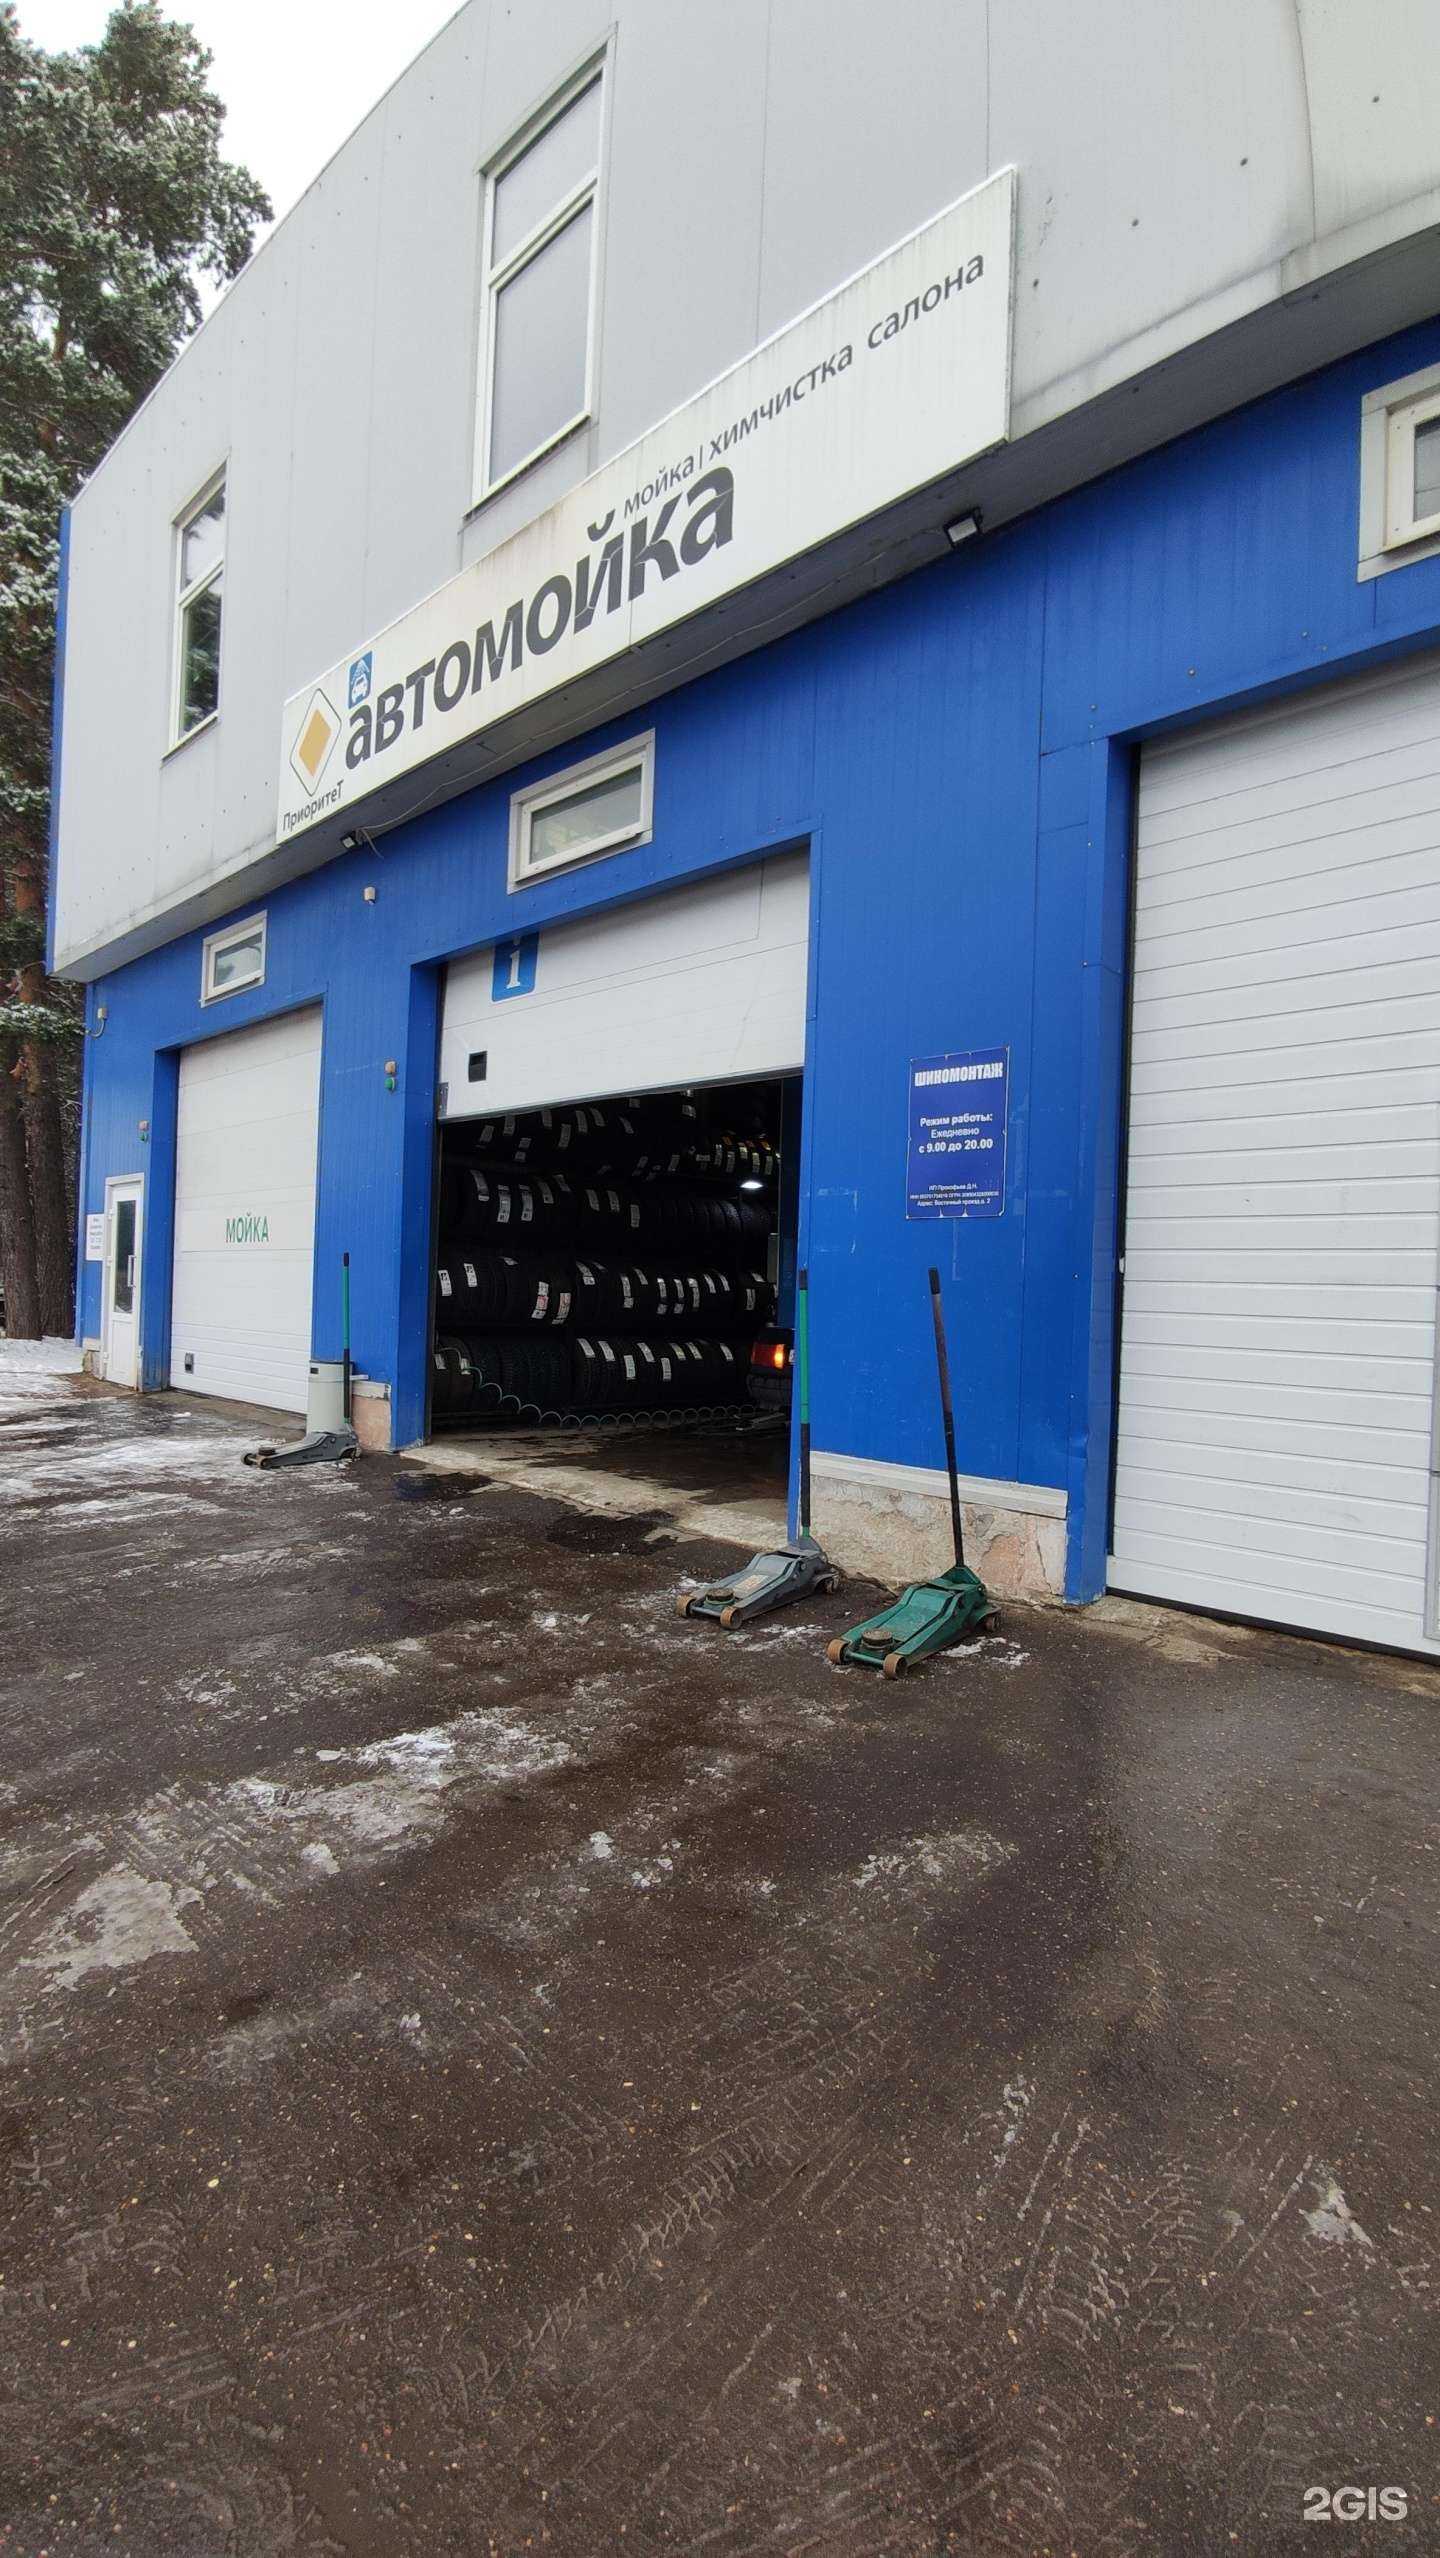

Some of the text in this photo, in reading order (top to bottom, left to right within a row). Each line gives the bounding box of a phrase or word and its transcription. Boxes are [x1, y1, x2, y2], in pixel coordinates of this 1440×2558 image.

[914, 1062, 1004, 1087] ШИНОМОНТАЖ
[920, 1113, 993, 1127] Режим работы:
[931, 1127, 980, 1139] Ежедневно
[926, 1141, 947, 1153] 9.00
[947, 1143, 962, 1153] до
[964, 1138, 994, 1150] 20.00
[225, 1211, 269, 1243] МОЙКА
